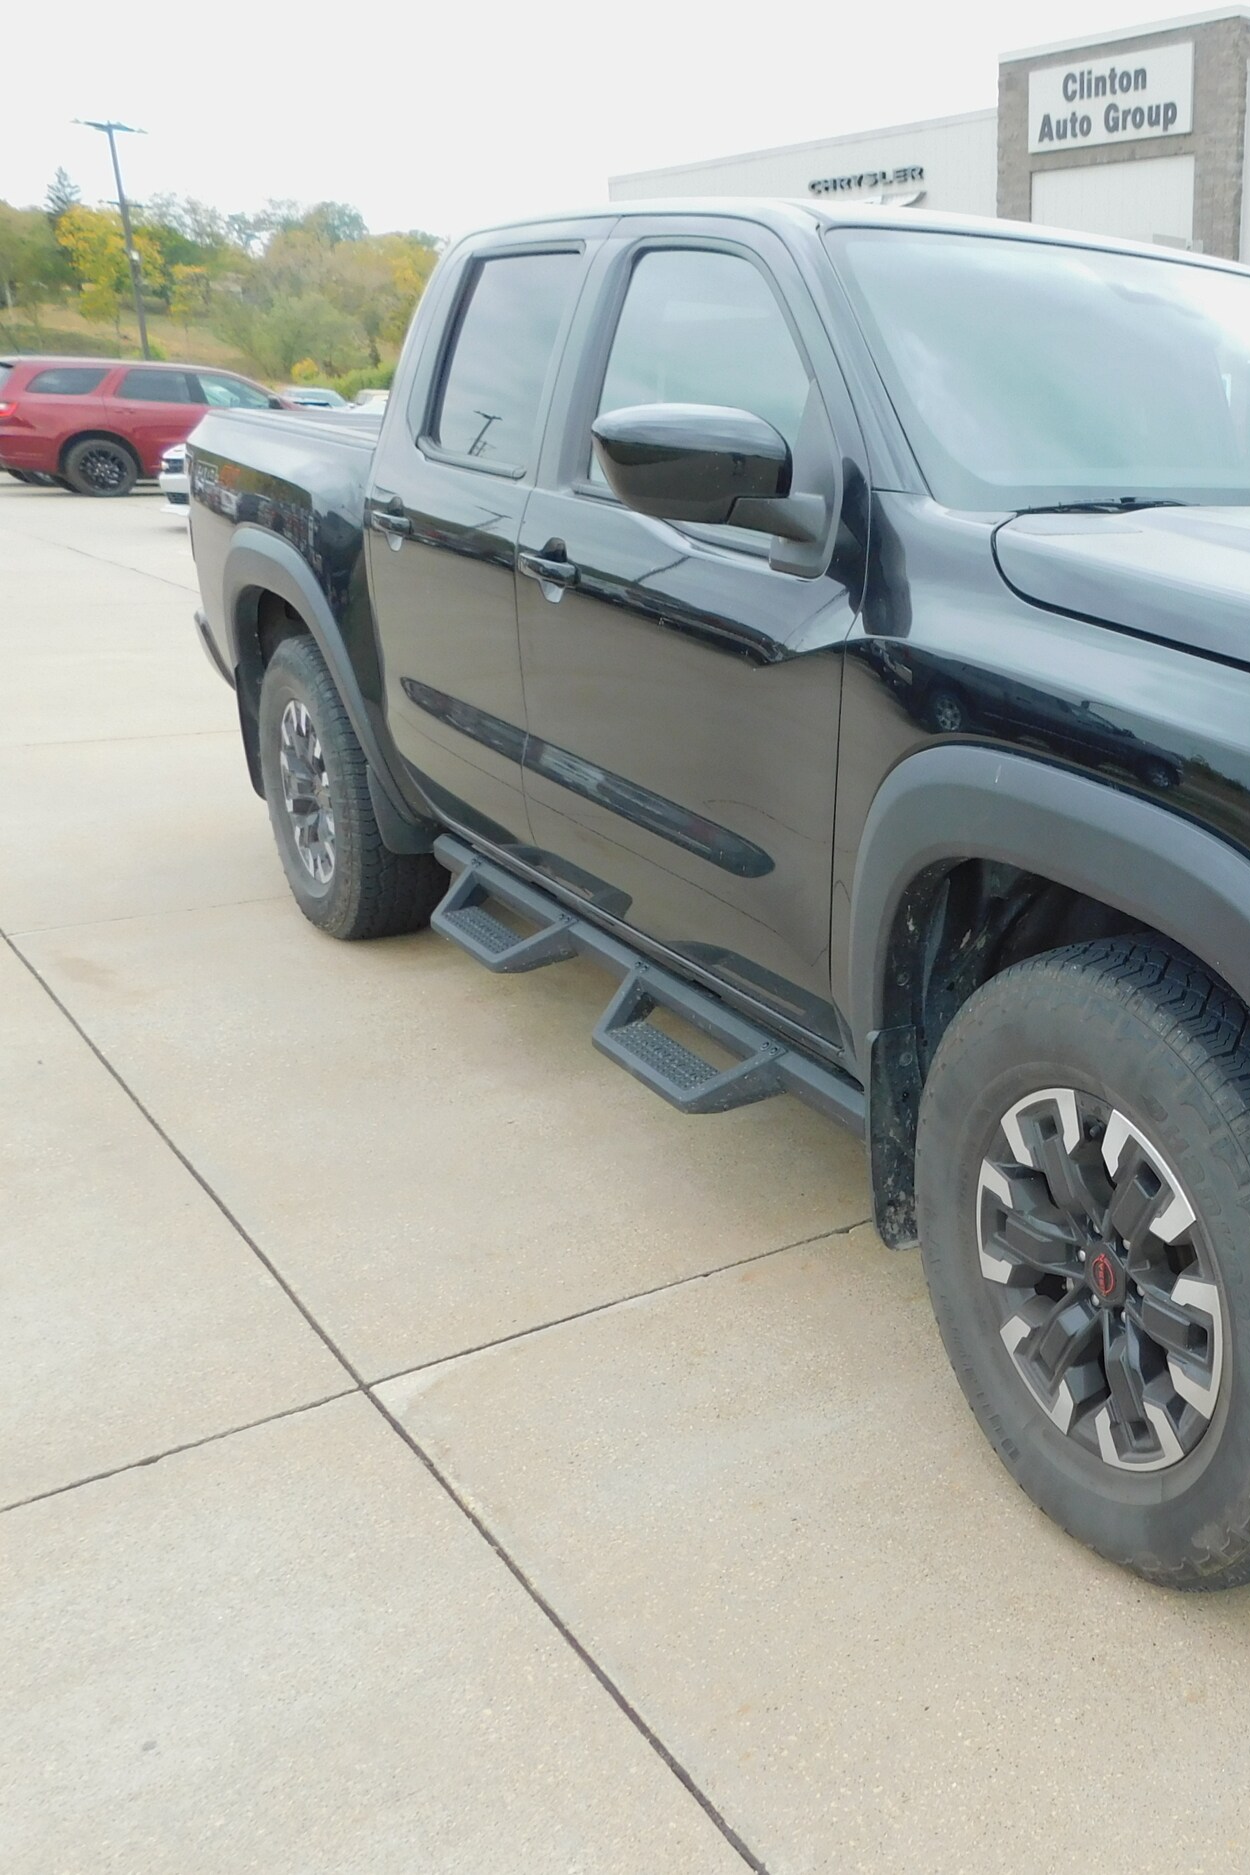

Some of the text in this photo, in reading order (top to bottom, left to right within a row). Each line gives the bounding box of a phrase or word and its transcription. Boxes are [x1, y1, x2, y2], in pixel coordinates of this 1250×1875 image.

[1062, 67, 1147, 102] Clinton
[1038, 101, 1177, 143] Auto Group
[808, 165, 924, 194] CHRYSLER
